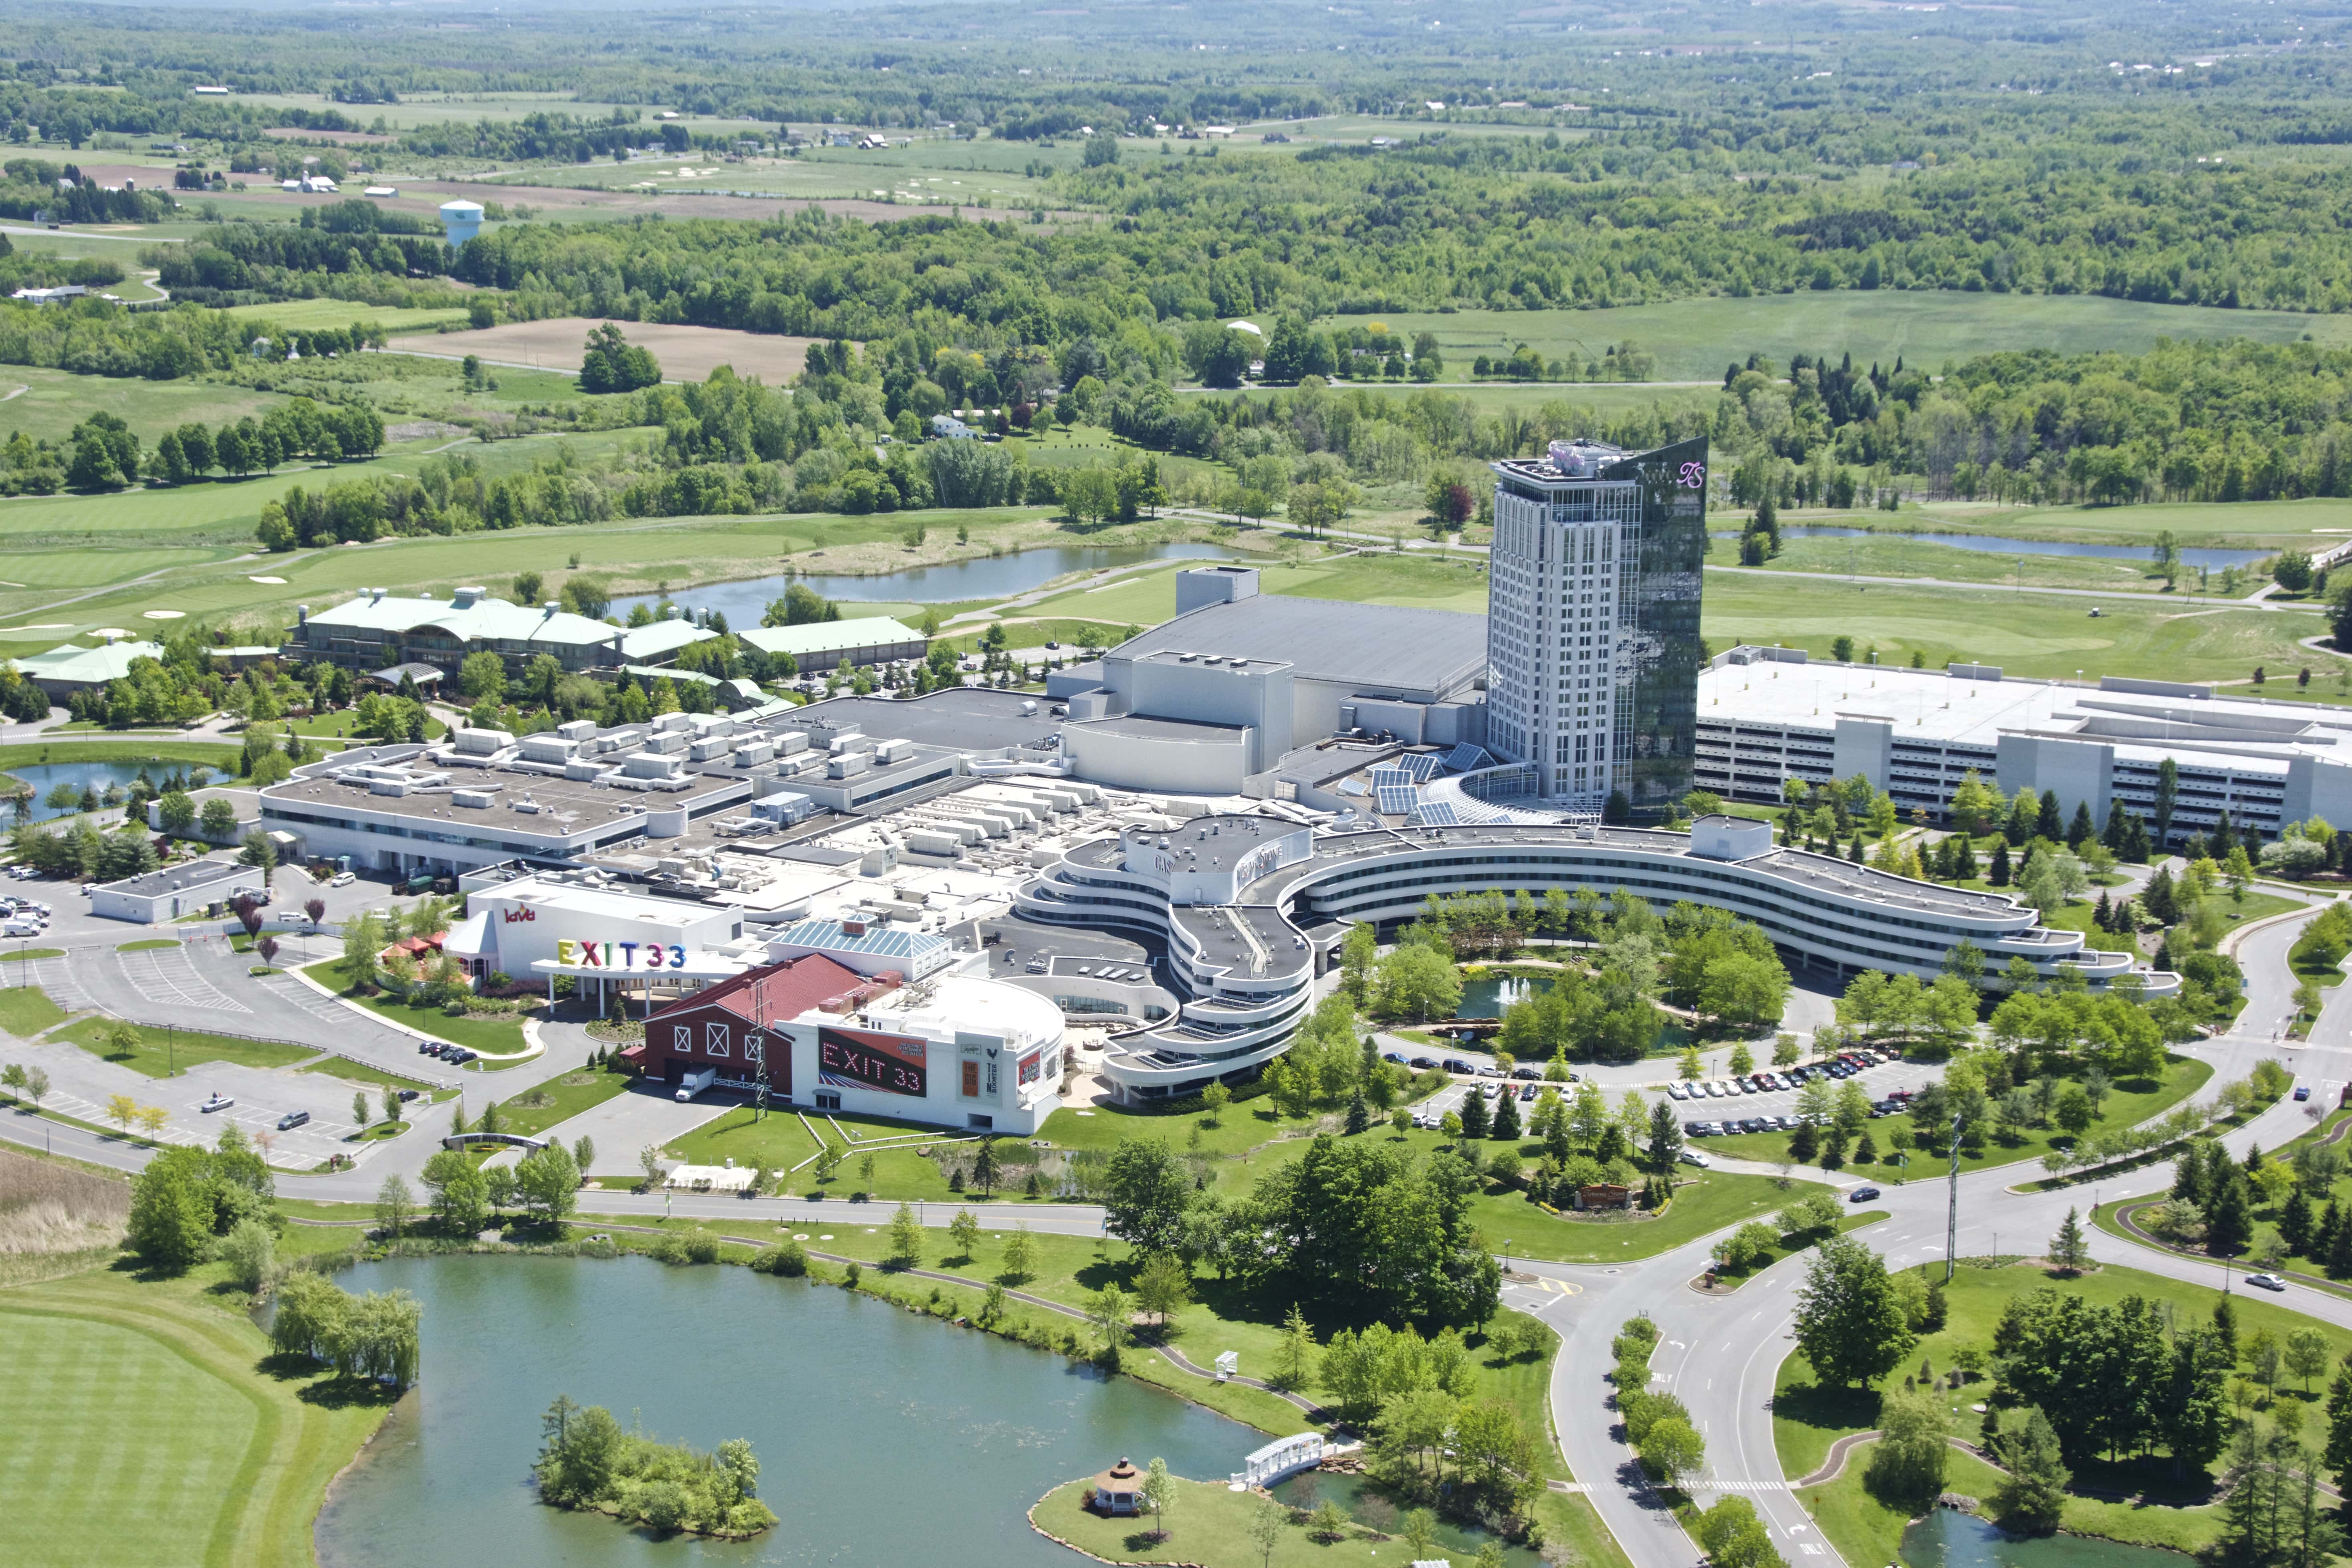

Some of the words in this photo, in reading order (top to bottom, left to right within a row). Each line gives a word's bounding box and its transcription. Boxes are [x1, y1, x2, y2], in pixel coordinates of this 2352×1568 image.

[558, 939, 639, 967] EXIT
[646, 942, 686, 968] 33
[823, 1042, 886, 1080] EXIT
[894, 1068, 920, 1091] 33
[964, 1063, 976, 1073] THE
[965, 1074, 976, 1085] GIG
[501, 1137, 524, 1147] ZONE
[1651, 1372, 1672, 1383] ONLY
[1799, 1543, 1826, 1555] ONLY
